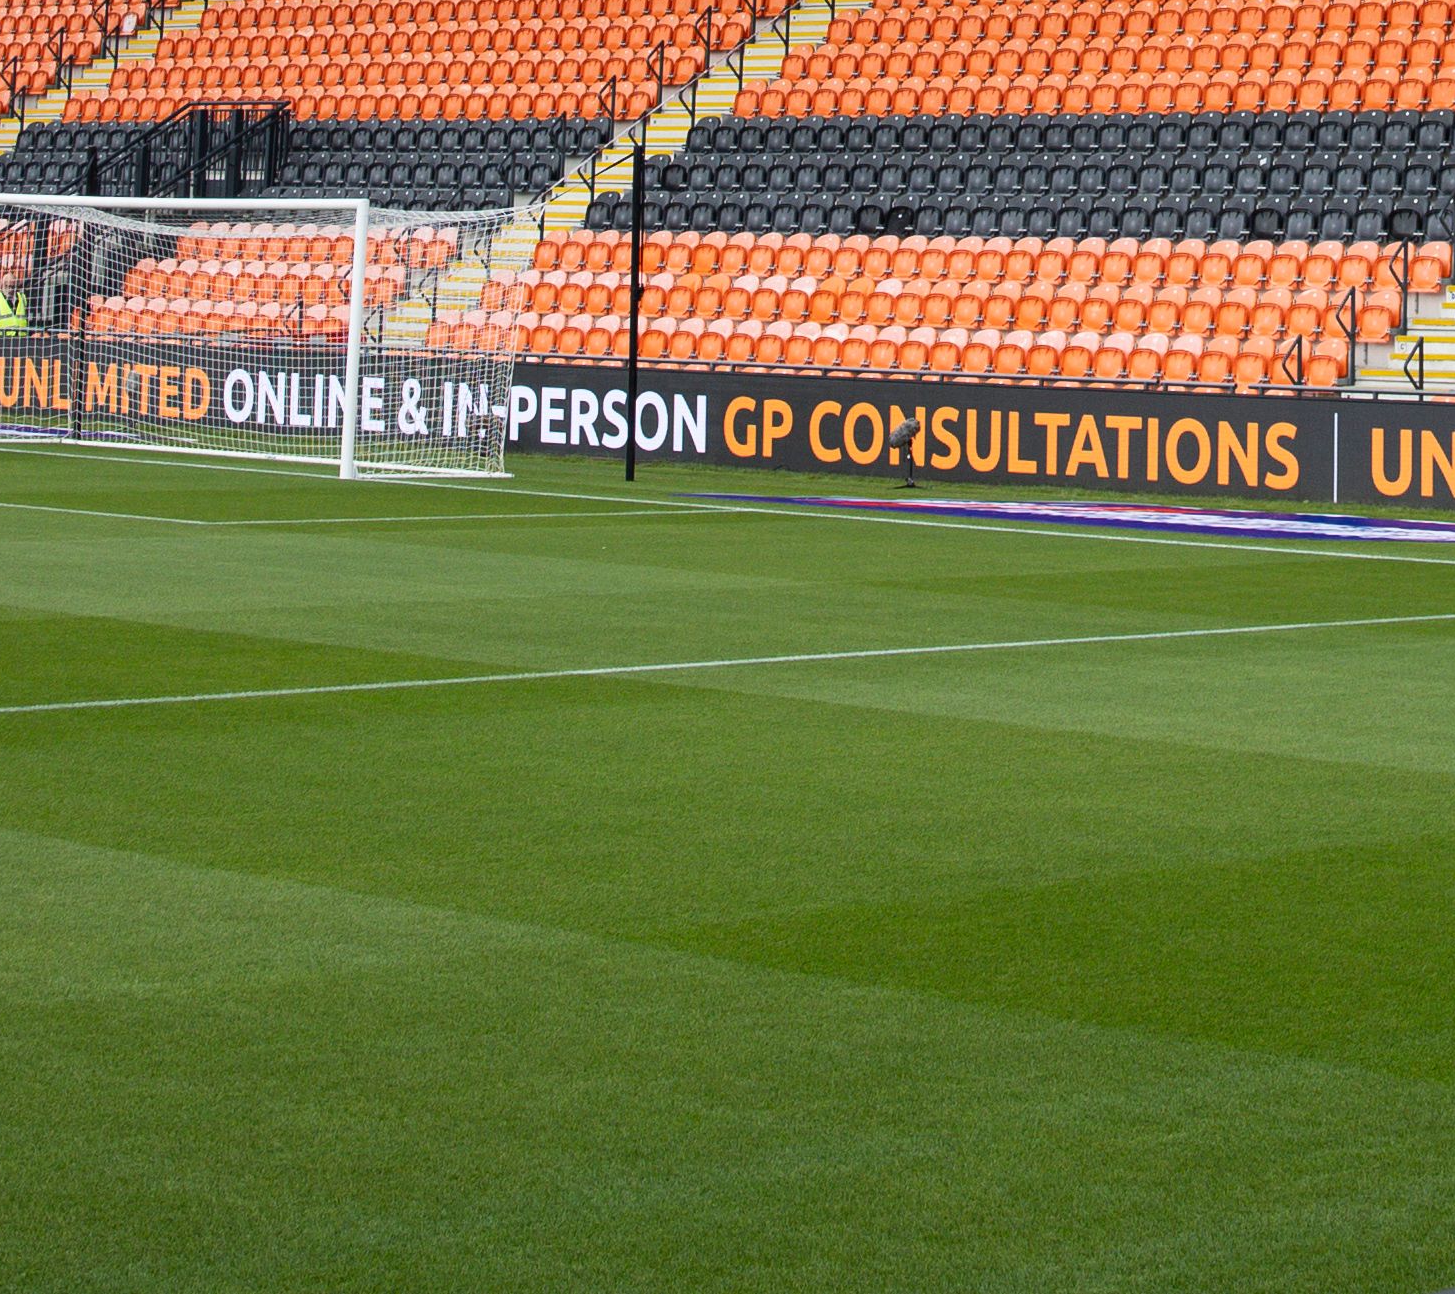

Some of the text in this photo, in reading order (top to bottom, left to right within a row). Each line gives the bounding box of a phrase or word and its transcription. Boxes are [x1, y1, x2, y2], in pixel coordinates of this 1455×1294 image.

[398, 377, 429, 435] &
[442, 381, 707, 453] IN-PERSON
[723, 396, 793, 458] GP
[809, 400, 1300, 490] CONSULTATIONS
